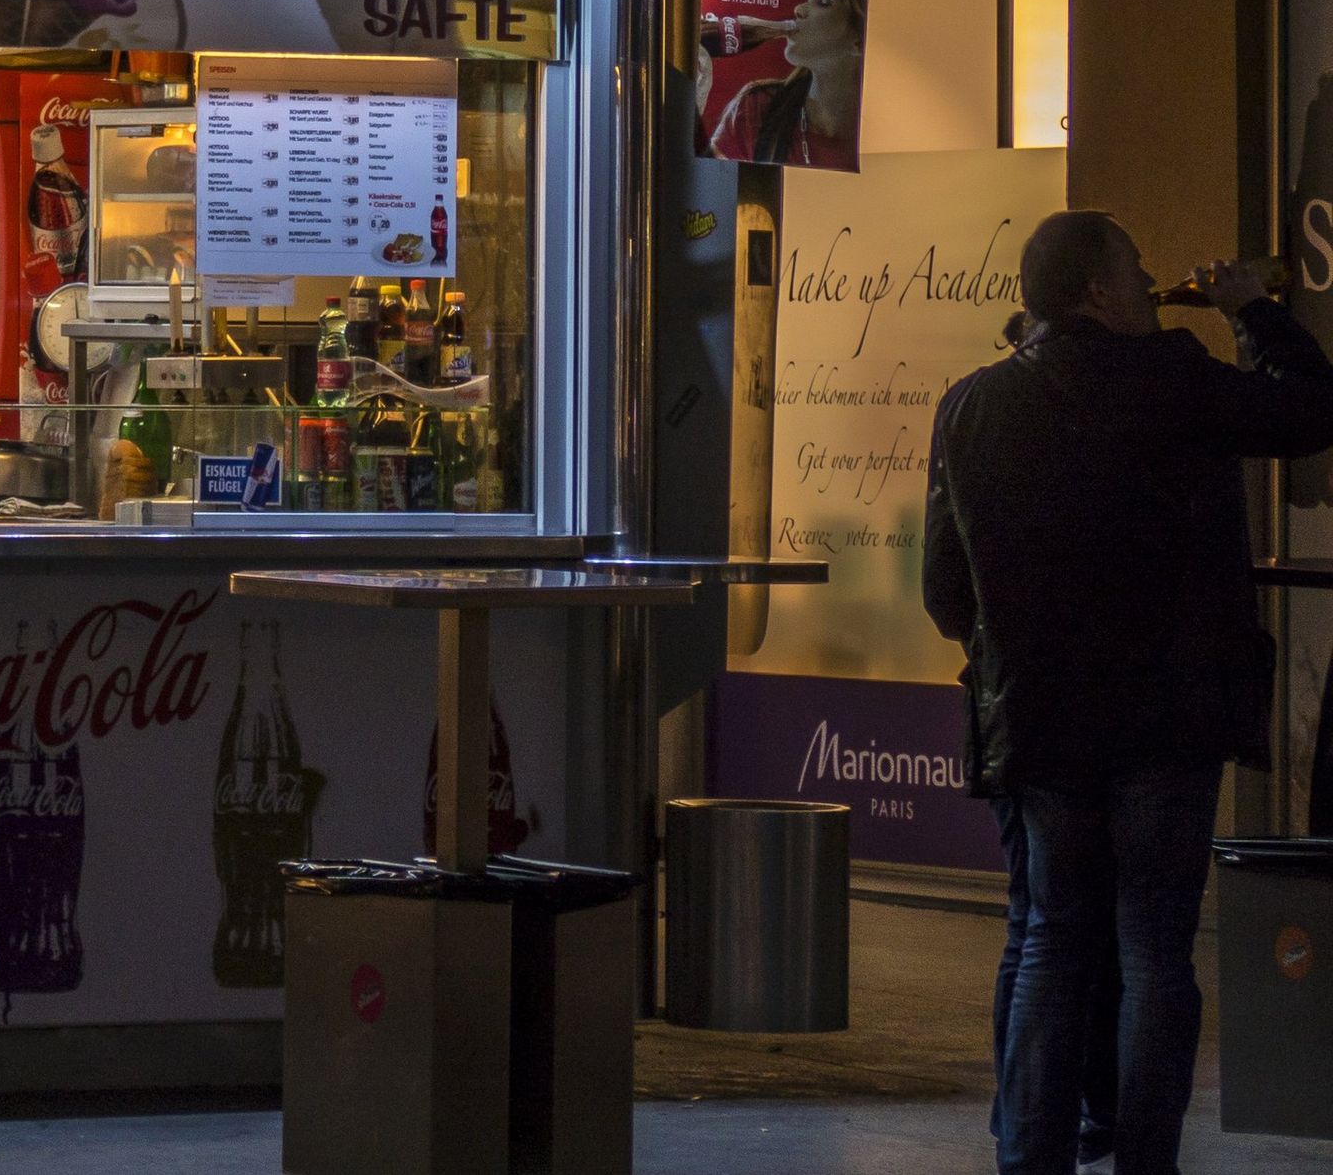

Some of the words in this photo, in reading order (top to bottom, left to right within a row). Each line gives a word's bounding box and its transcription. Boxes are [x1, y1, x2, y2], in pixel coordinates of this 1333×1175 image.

[851, 262, 892, 360] up
[806, 364, 866, 407] bekomme
[871, 361, 907, 407] ich
[898, 382, 932, 407] mein
[205, 464, 247, 478] EISKALTE
[208, 478, 243, 493] FLÜGEL
[797, 441, 825, 485] Get
[818, 453, 860, 494] your
[855, 426, 915, 506] perfect
[798, 720, 966, 793] Marionnau
[871, 798, 915, 821] PARIS
